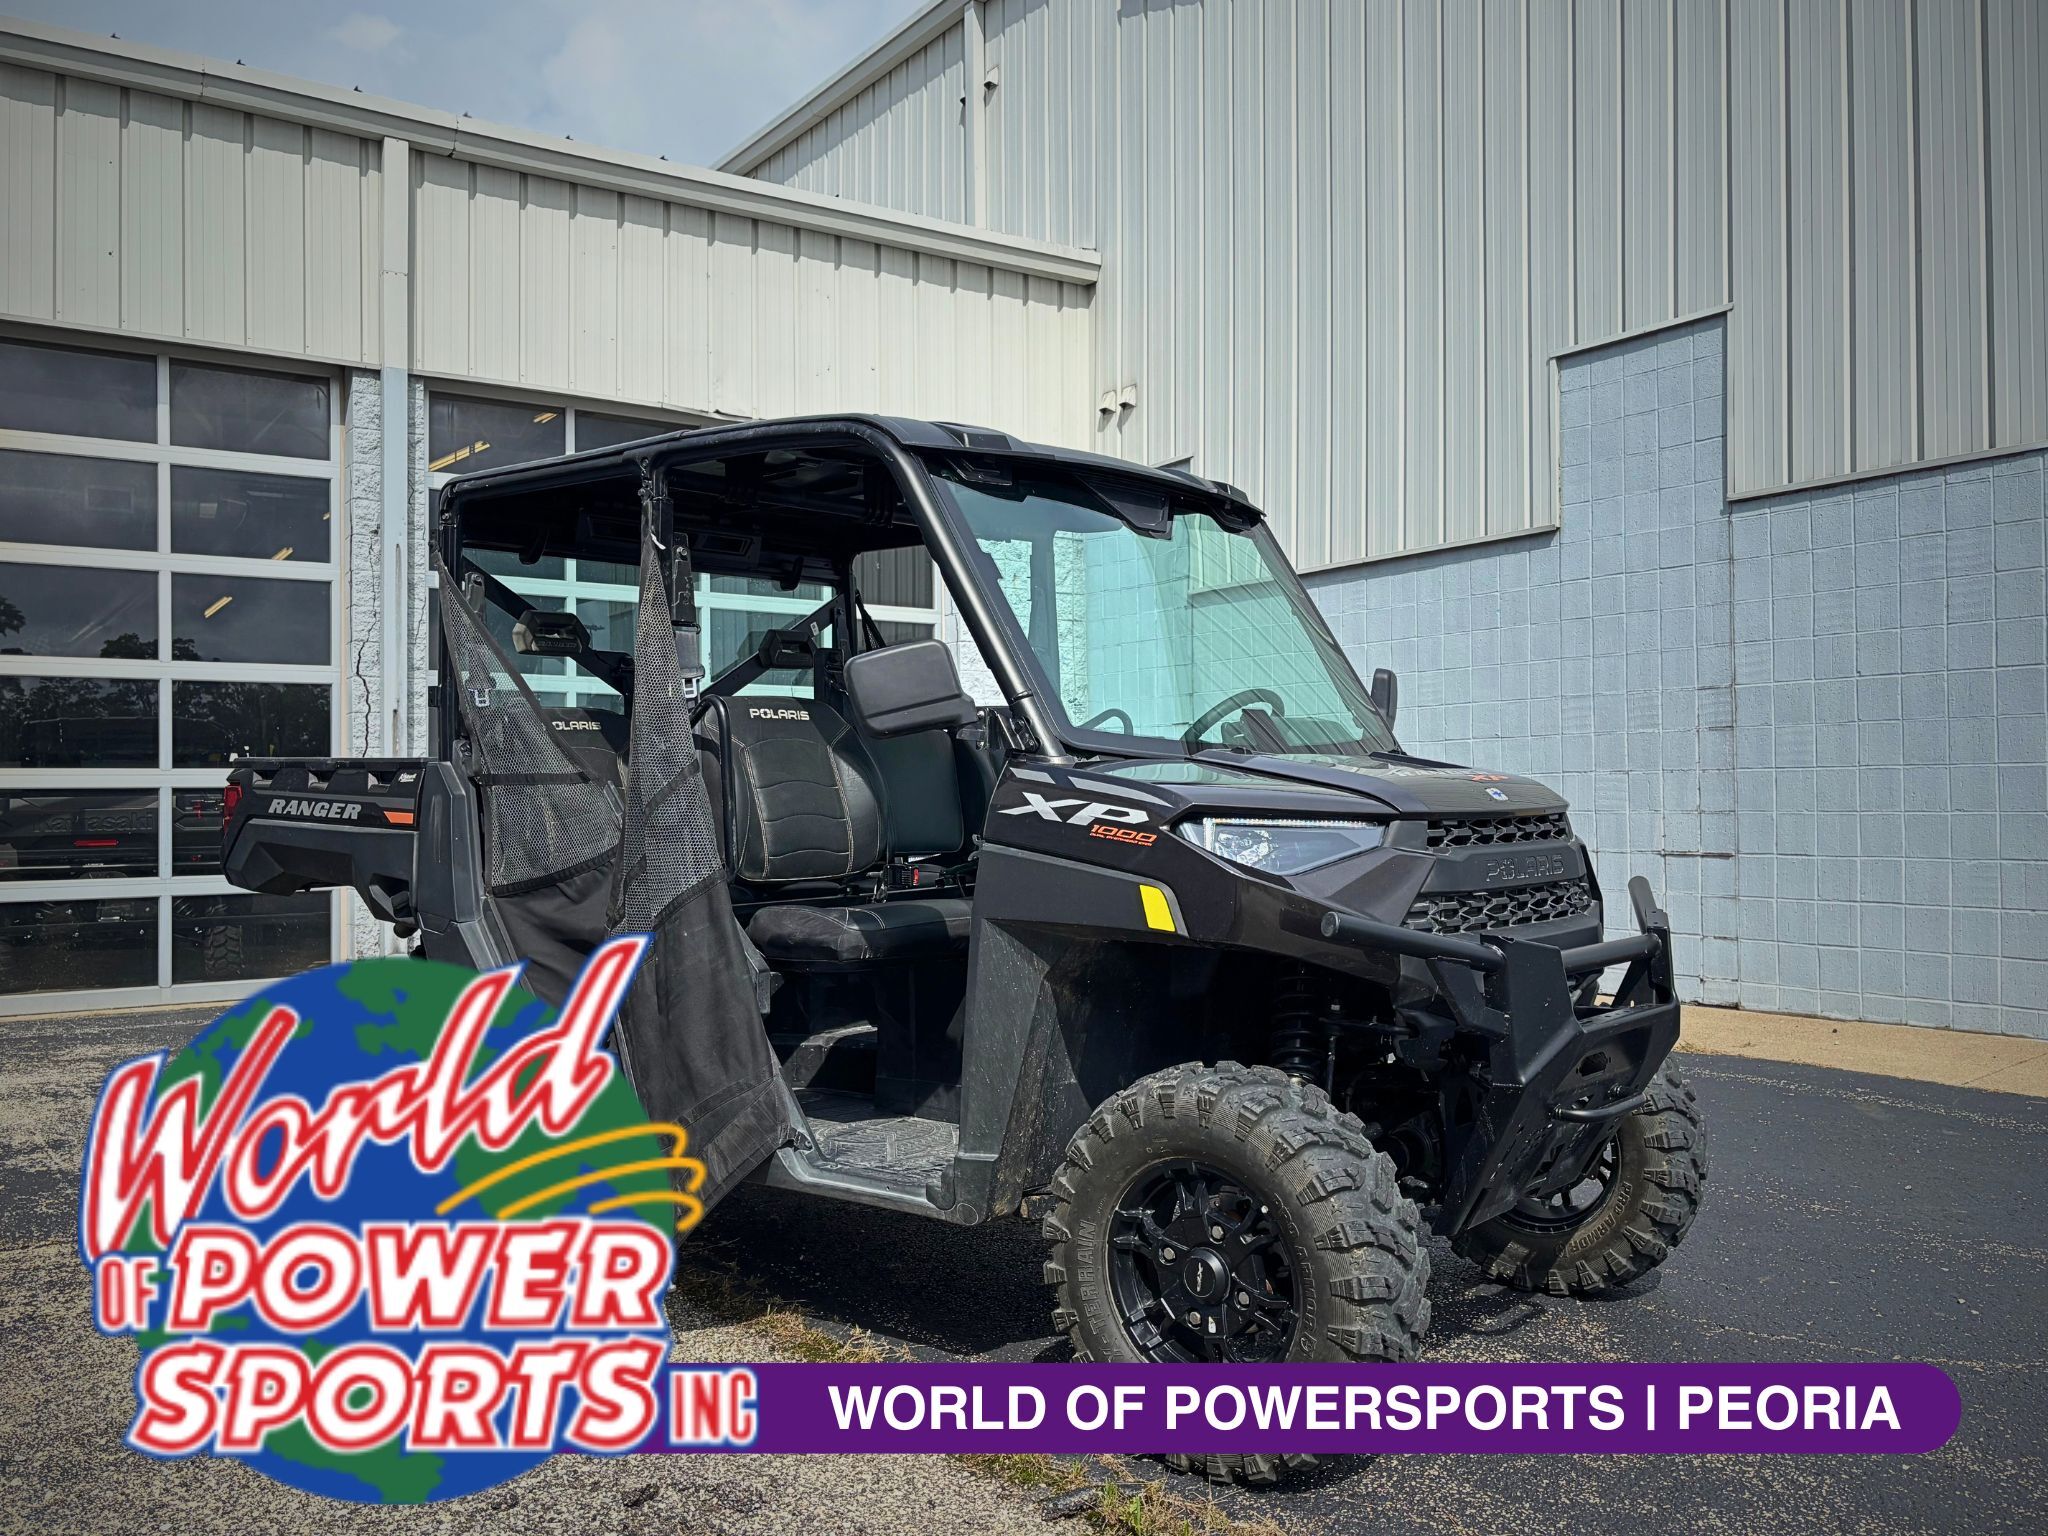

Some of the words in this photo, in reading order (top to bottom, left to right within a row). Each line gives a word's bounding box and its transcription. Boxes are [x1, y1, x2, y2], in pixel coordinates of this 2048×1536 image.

[749, 708, 810, 721] POLARIS
[552, 720, 601, 731] OLARIS
[268, 798, 362, 820] RANGER
[997, 791, 1150, 826] XP
[33, 812, 154, 833] Kaasaki
[1091, 824, 1157, 842] 1000
[1486, 854, 1564, 882] POLARIS
[1568, 1212, 1617, 1253] ARMOR
